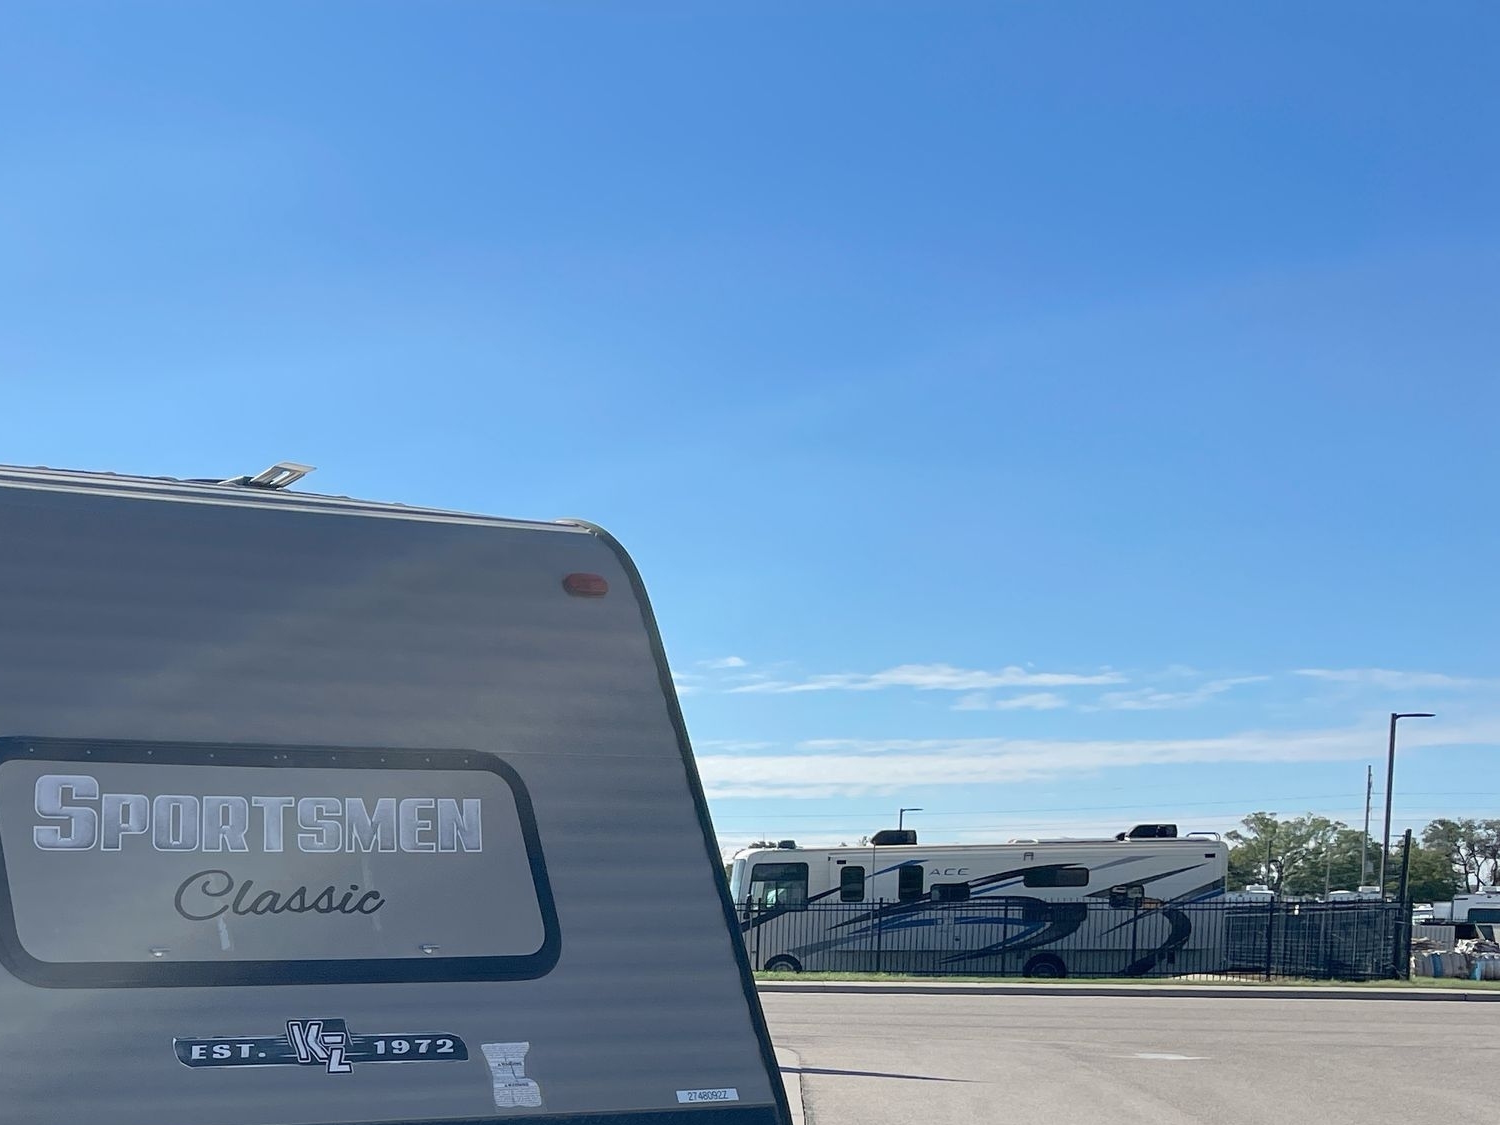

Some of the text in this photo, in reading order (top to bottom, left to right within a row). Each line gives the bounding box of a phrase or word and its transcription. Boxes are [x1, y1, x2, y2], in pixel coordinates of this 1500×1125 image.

[33, 773, 483, 854] SPORTSMEN
[173, 868, 386, 922] Classic
[190, 1043, 267, 1060] EST.
[372, 1038, 455, 1055] 1972
